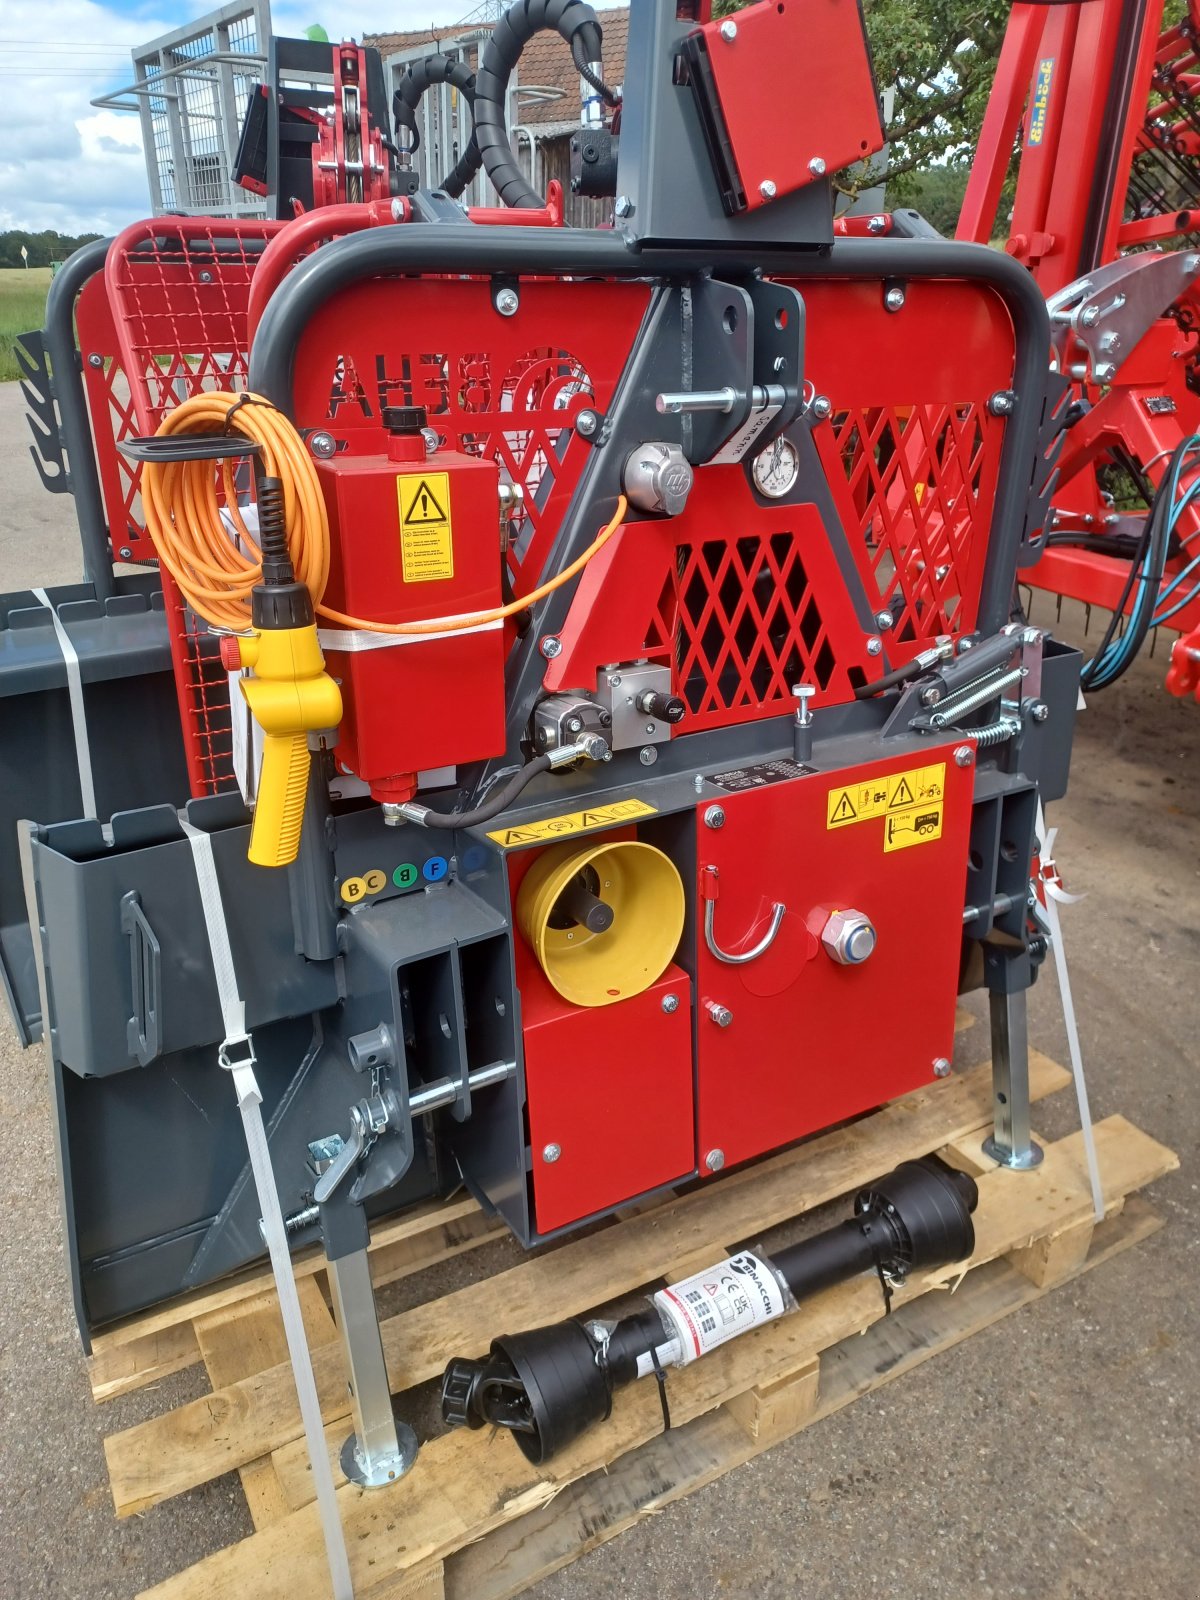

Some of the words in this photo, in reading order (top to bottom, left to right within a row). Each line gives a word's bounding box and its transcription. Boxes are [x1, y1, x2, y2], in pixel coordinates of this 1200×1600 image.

[1030, 62, 1052, 142] Einböck
[431, 862, 440, 876] F
[348, 883, 360, 897] B
[367, 875, 378, 889] C
[742, 1264, 772, 1315] BINACCHI
[733, 1299, 742, 1315] CA
[739, 1295, 750, 1311] UK
